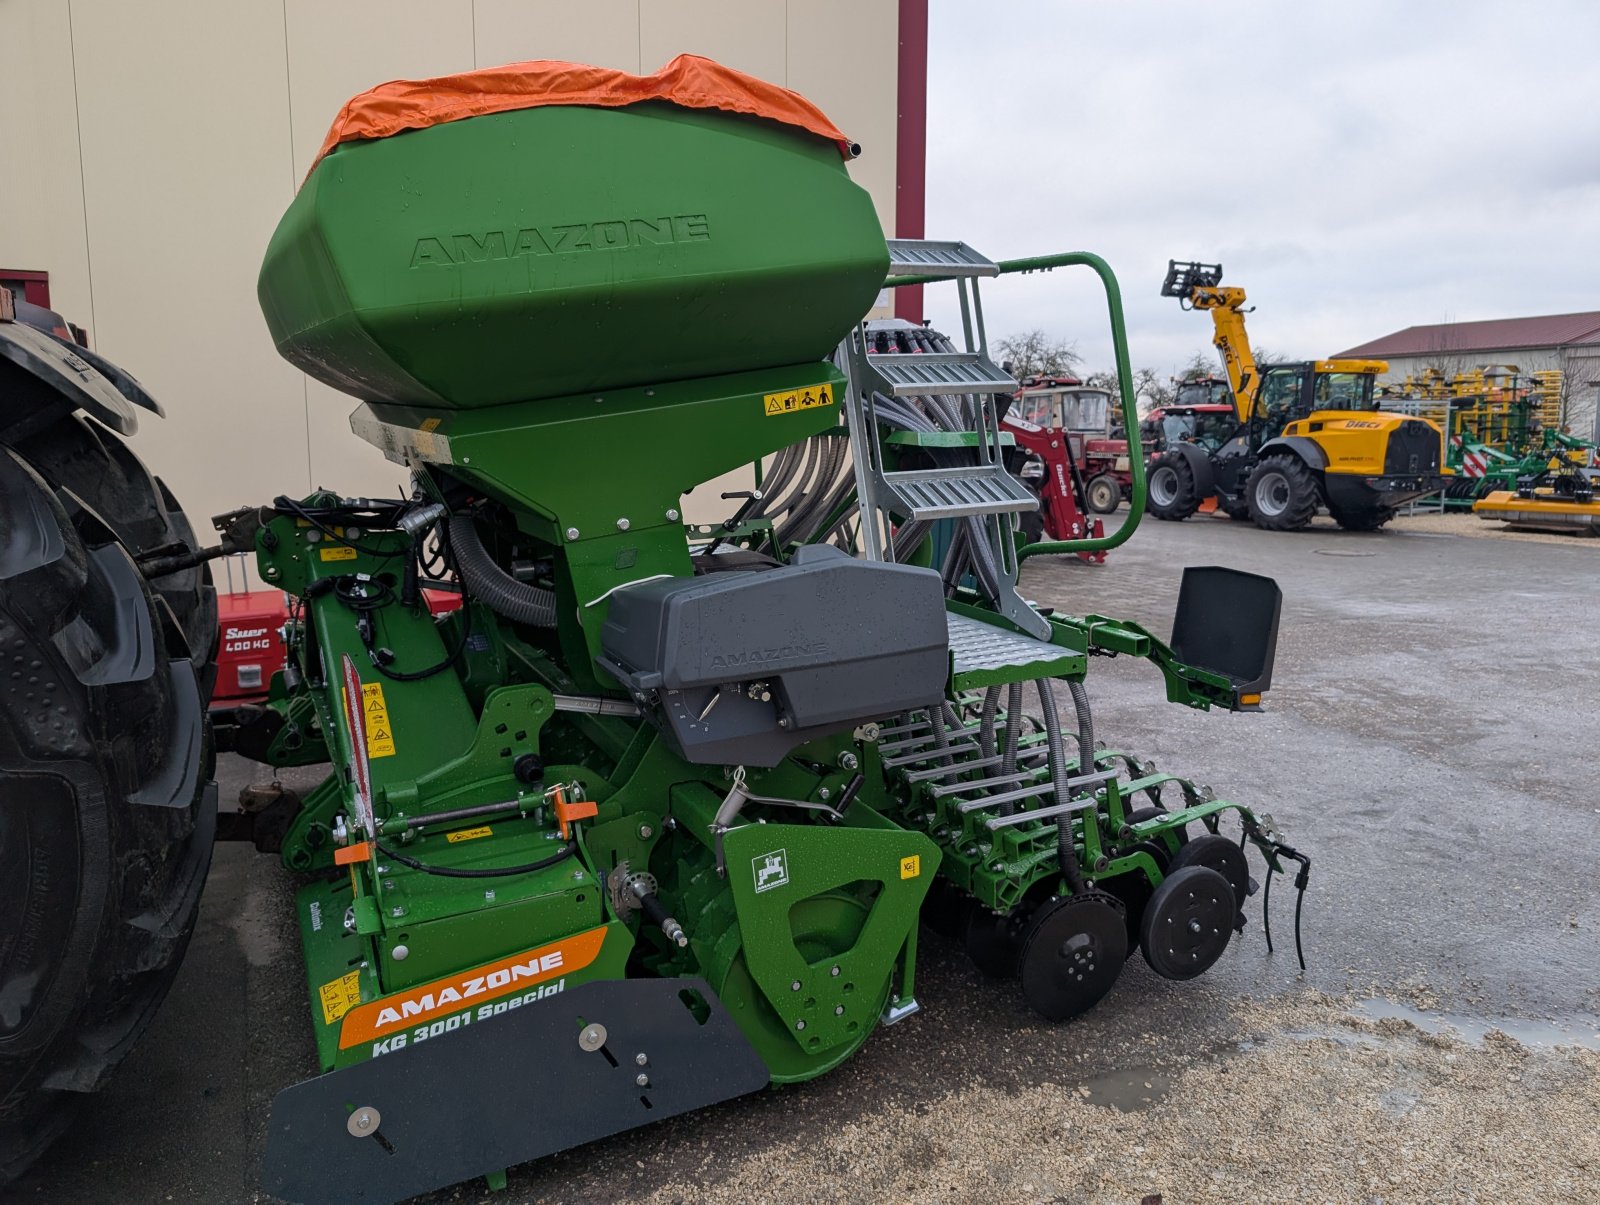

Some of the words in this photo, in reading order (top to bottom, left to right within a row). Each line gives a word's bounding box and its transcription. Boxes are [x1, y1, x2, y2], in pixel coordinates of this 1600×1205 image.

[409, 214, 710, 269] AMAZONE
[1345, 420, 1382, 429] DIECI
[226, 641, 250, 652] 400
[253, 639, 270, 649] KG
[711, 643, 829, 669] AMAZONE
[374, 951, 564, 1028] AMAZONE
[372, 1034, 408, 1058] KG
[413, 1011, 472, 1041] 3001
[477, 978, 565, 1021] Special
